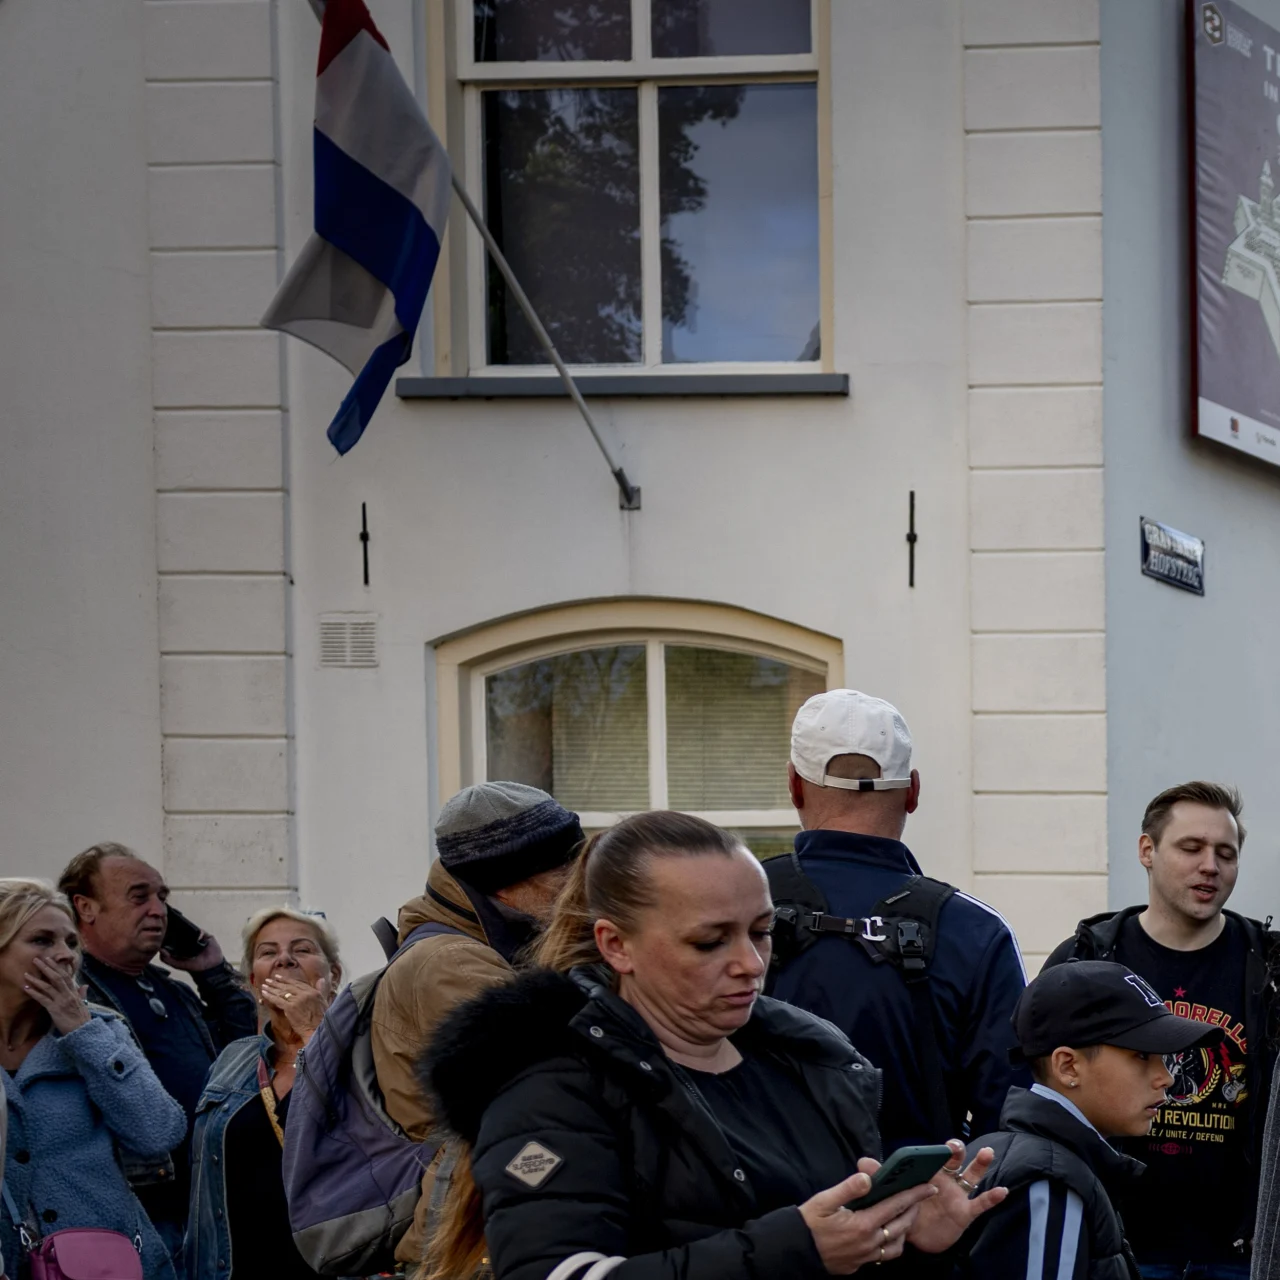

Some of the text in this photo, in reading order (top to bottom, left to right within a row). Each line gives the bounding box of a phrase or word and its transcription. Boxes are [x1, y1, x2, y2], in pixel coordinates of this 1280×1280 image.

[1263, 81, 1278, 103] IN
[1164, 1109, 1235, 1130] REVOLUTION
[1165, 1129, 1188, 1139] UNITE
[1196, 1132, 1224, 1143] DEFEND
